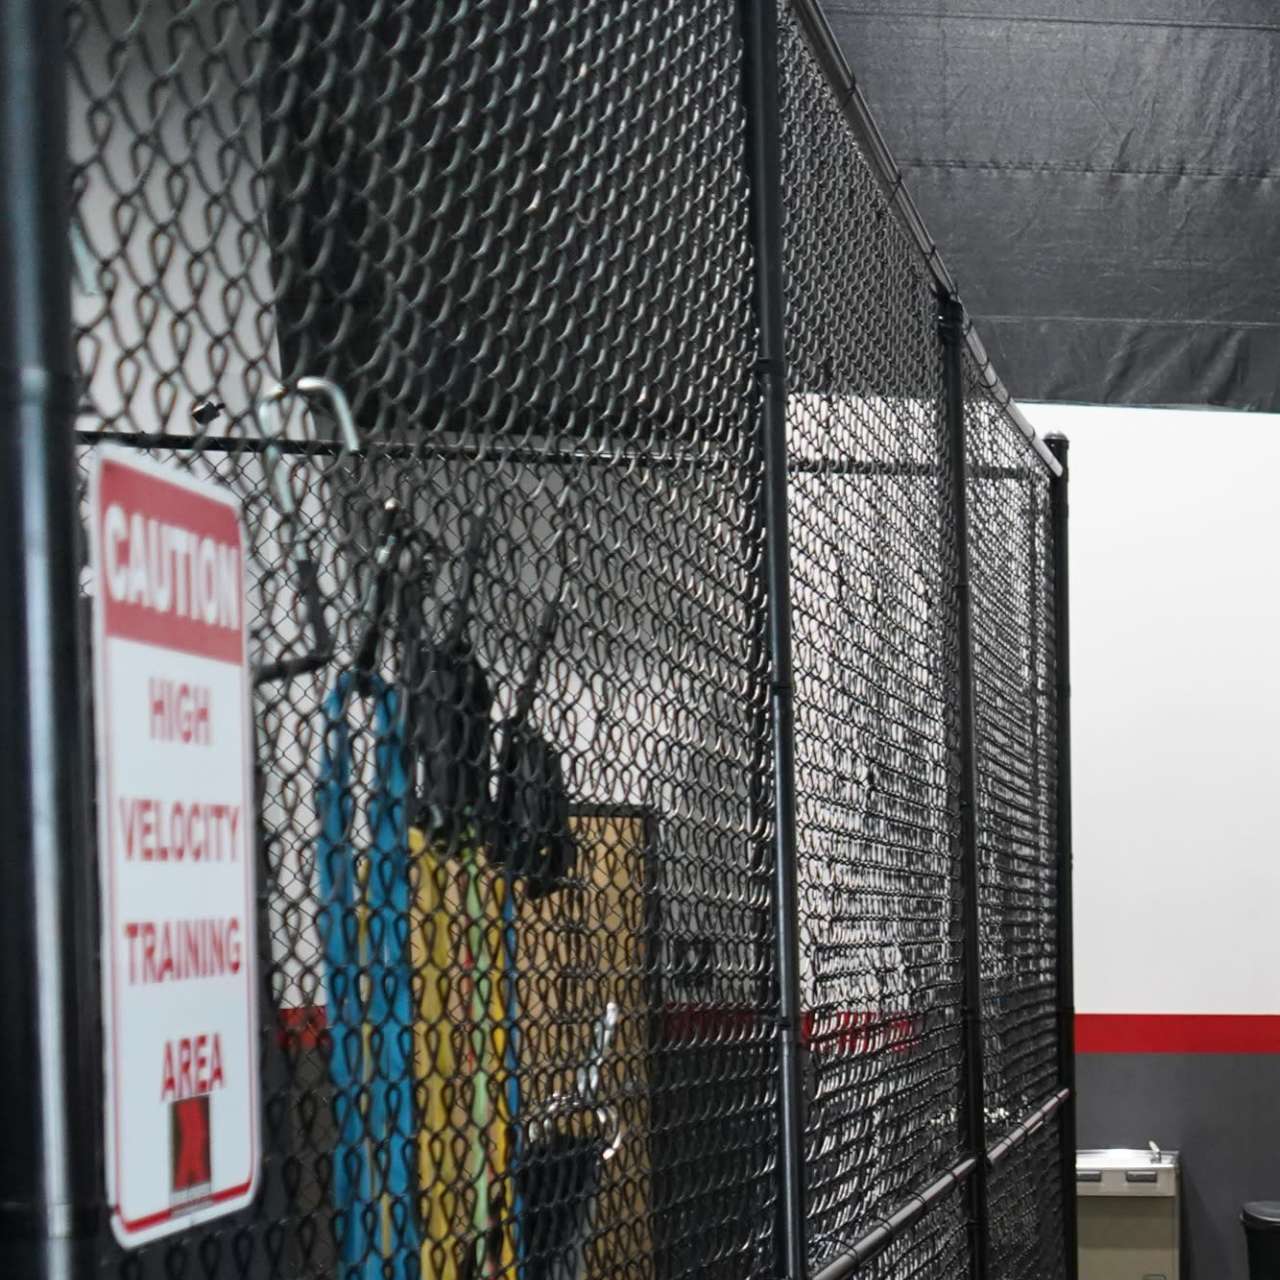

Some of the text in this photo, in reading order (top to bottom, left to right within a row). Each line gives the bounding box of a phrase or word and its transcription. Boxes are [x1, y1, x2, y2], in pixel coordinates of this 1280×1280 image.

[103, 504, 240, 631] CAUTION
[149, 676, 213, 747] HIGH
[120, 797, 241, 863] VELOCITY
[122, 916, 241, 986] TRAINING
[161, 1032, 225, 1102] AREA
